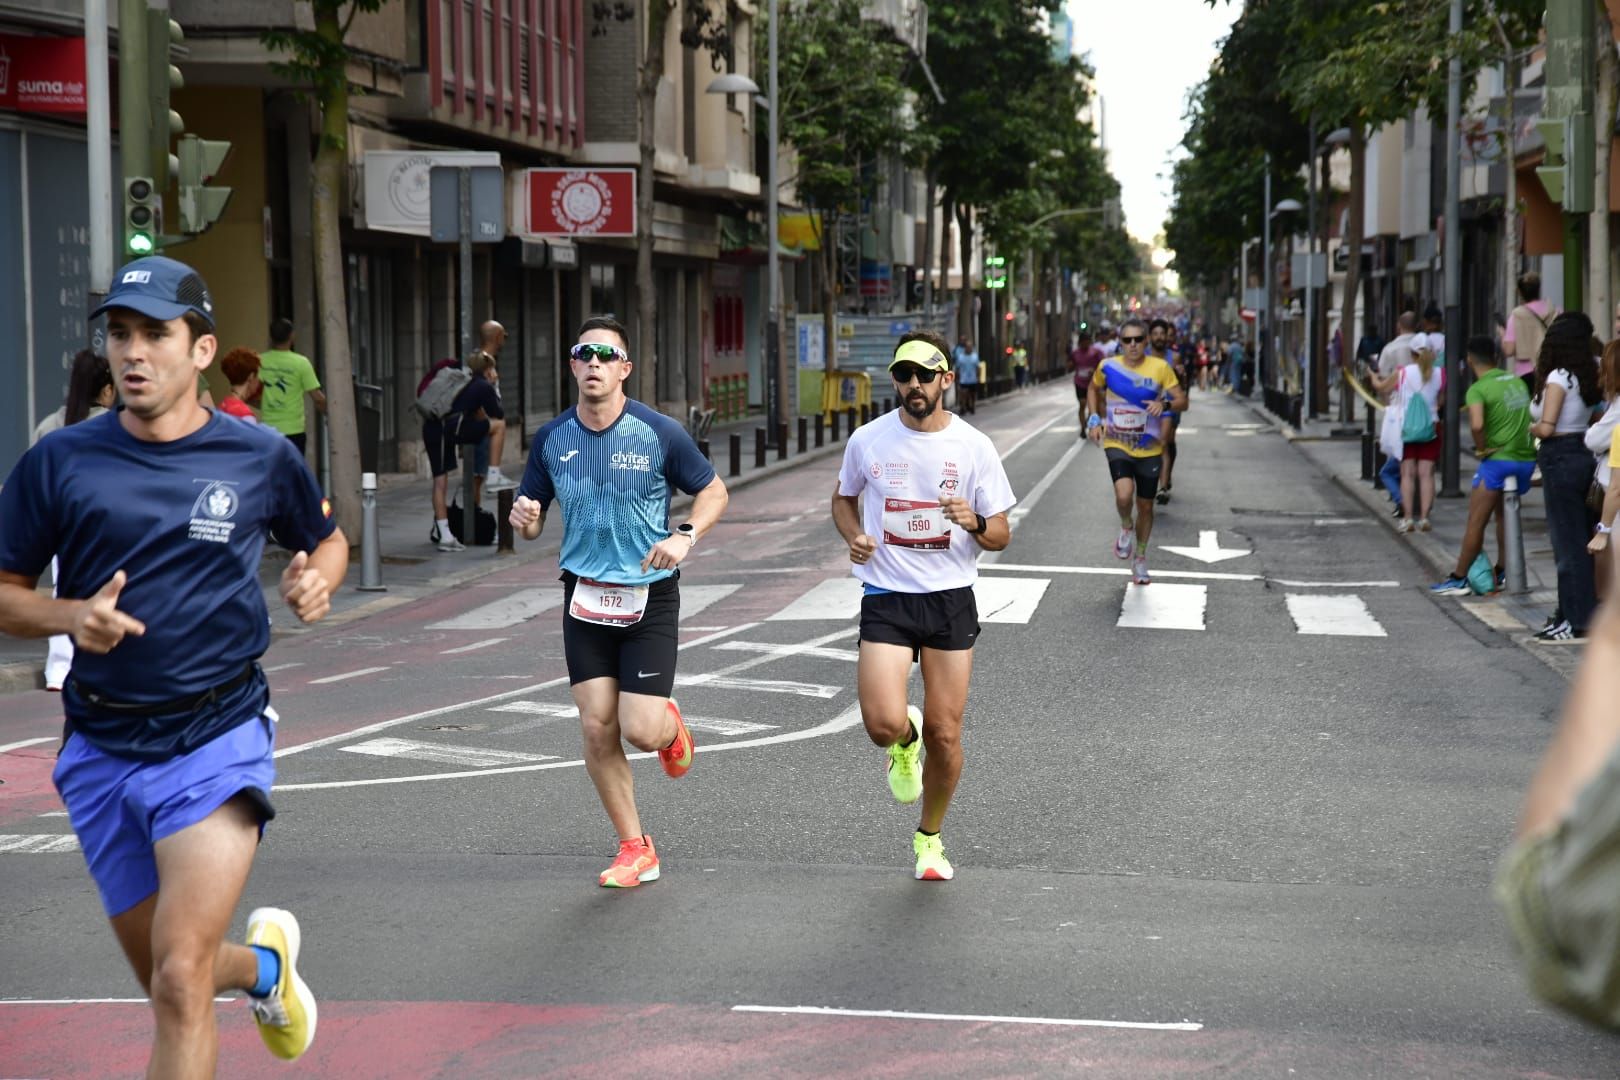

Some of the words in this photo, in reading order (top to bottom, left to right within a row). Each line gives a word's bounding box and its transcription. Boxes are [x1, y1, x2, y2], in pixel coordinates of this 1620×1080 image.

[17, 80, 63, 94] suma
[611, 450, 649, 465] civitas
[189, 518, 236, 530] ANIVERSARIO
[907, 519, 930, 532] 1590
[599, 595, 622, 608] 1572
